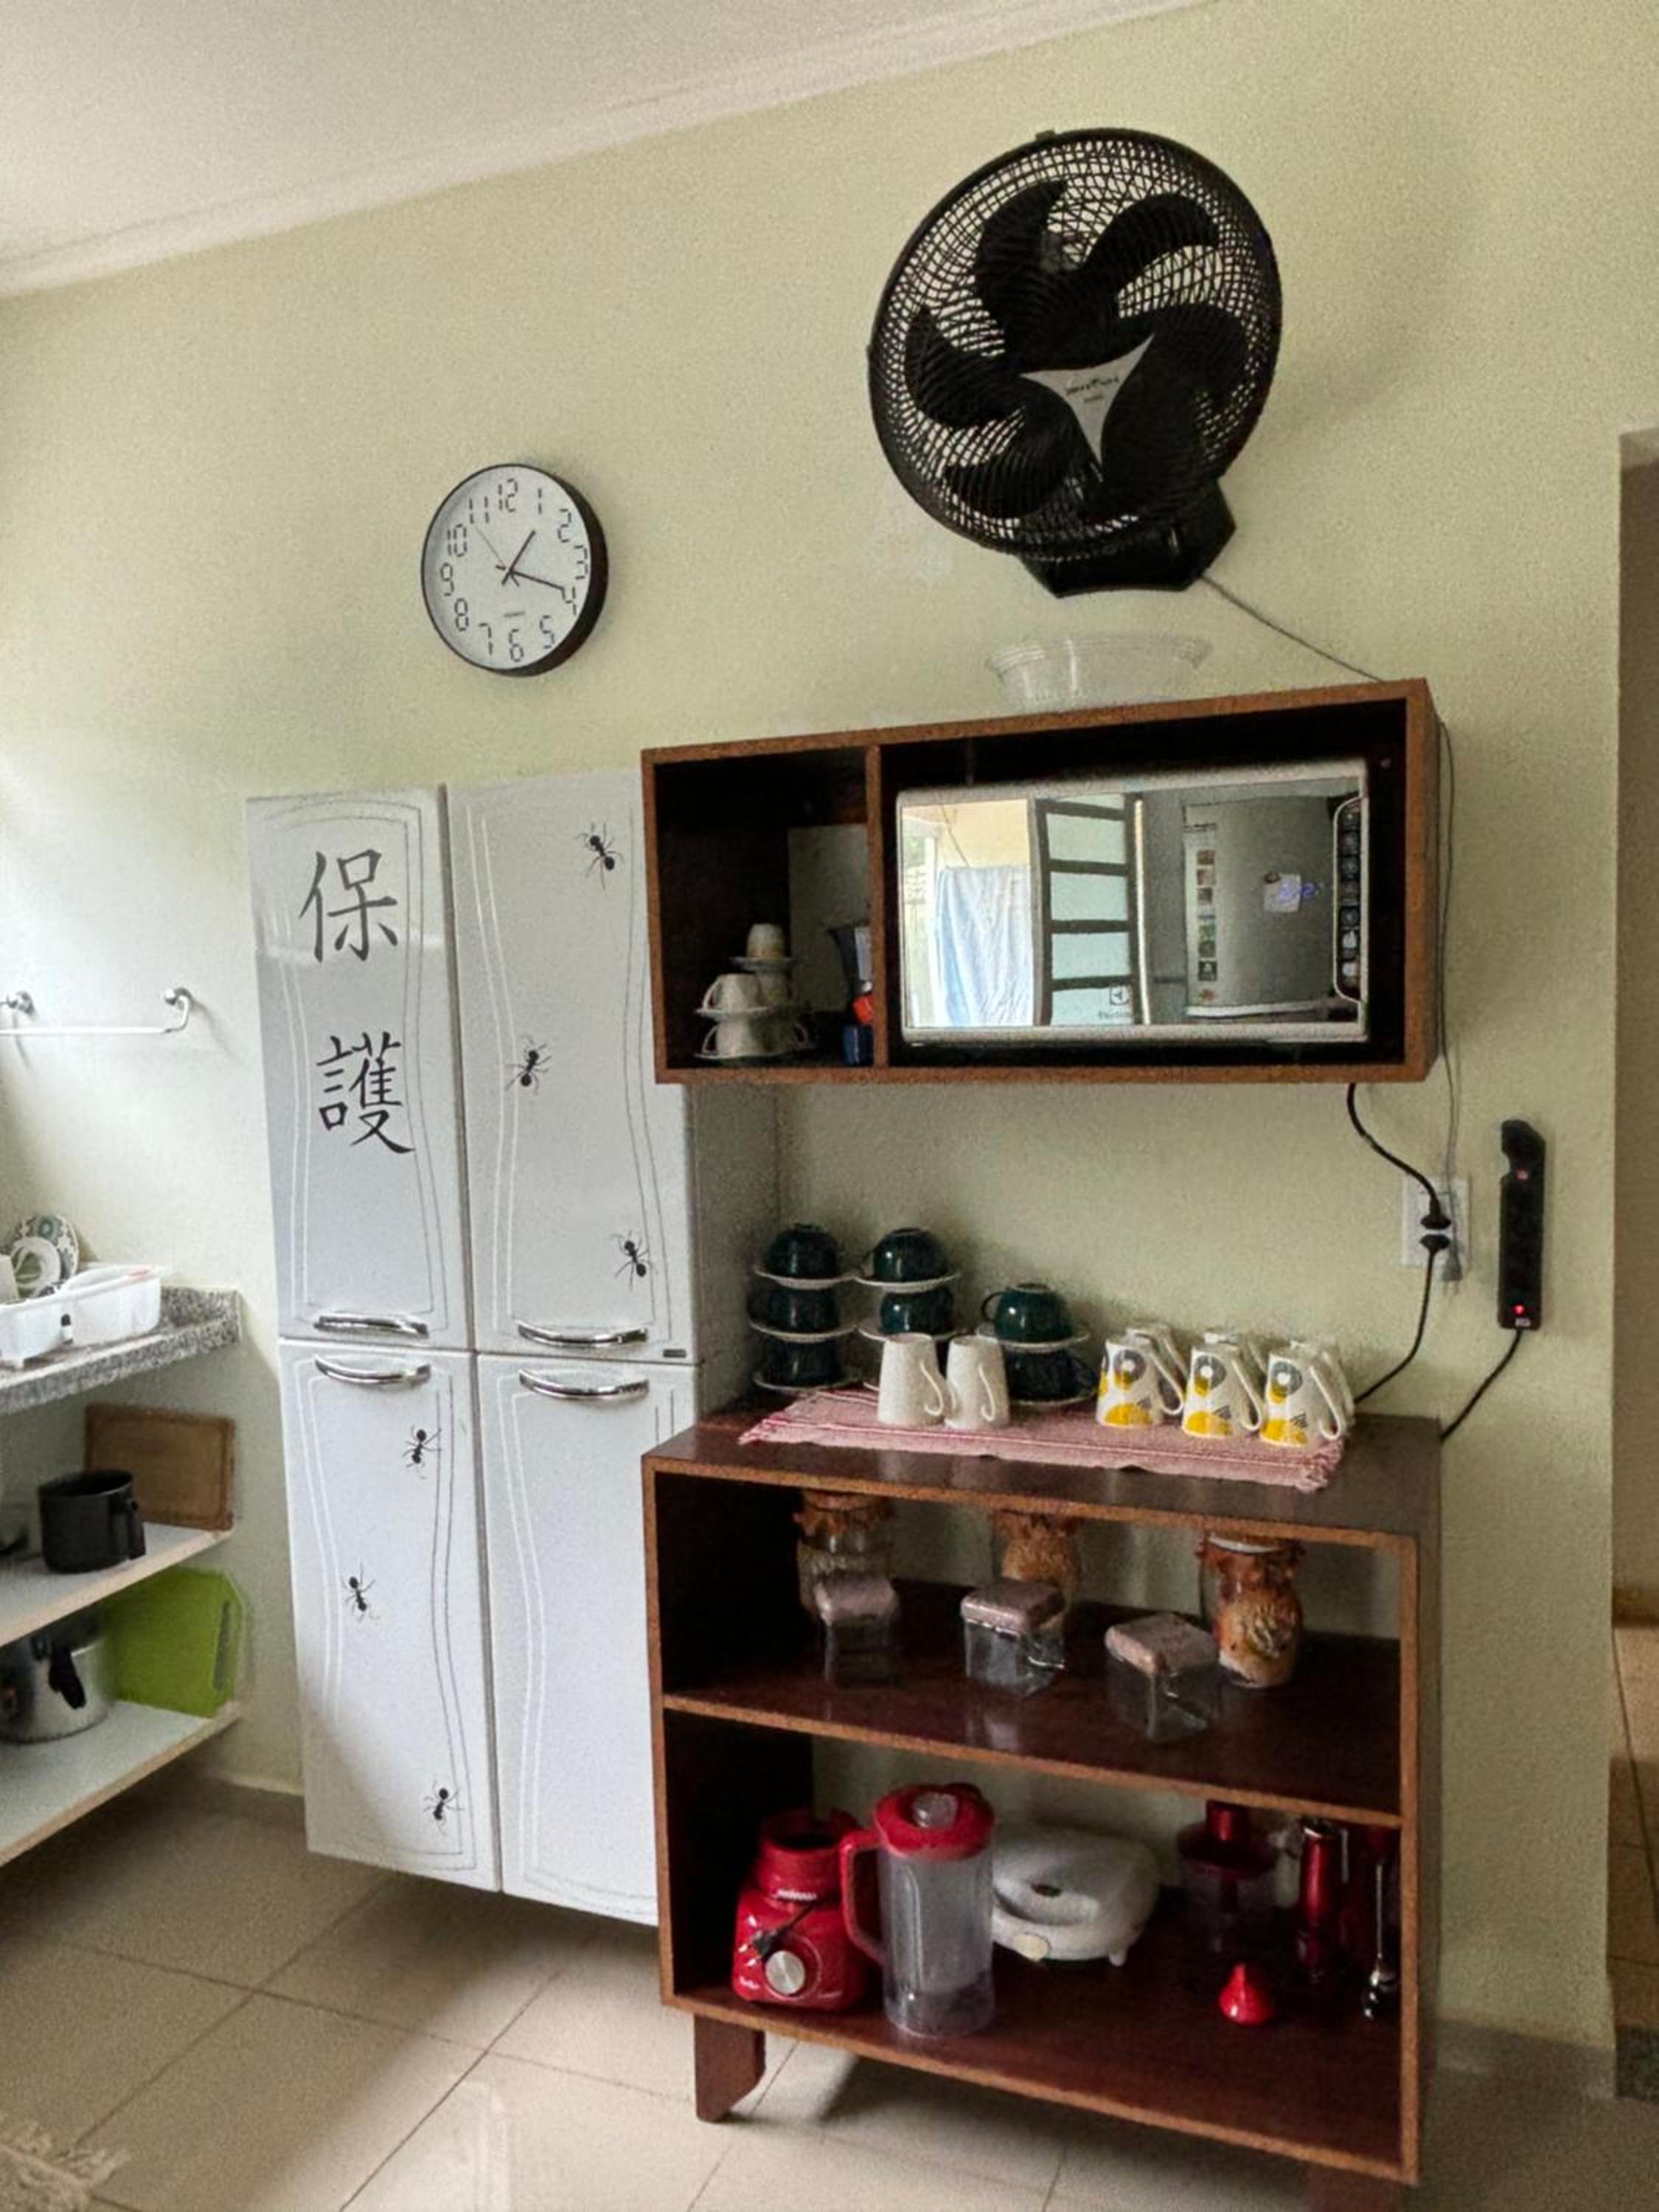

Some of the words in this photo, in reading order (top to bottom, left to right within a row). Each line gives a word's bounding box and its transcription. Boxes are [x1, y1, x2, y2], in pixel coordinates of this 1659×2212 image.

[468, 495, 490, 524] 11
[498, 477, 518, 512] 12
[446, 524, 467, 557] 10
[557, 507, 572, 543] 2
[439, 562, 455, 597] 9
[574, 544, 589, 580] 3
[453, 597, 470, 632] 8
[561, 586, 578, 616] 4
[479, 622, 494, 655] 7
[508, 628, 524, 662] 6
[539, 614, 555, 650] 5
